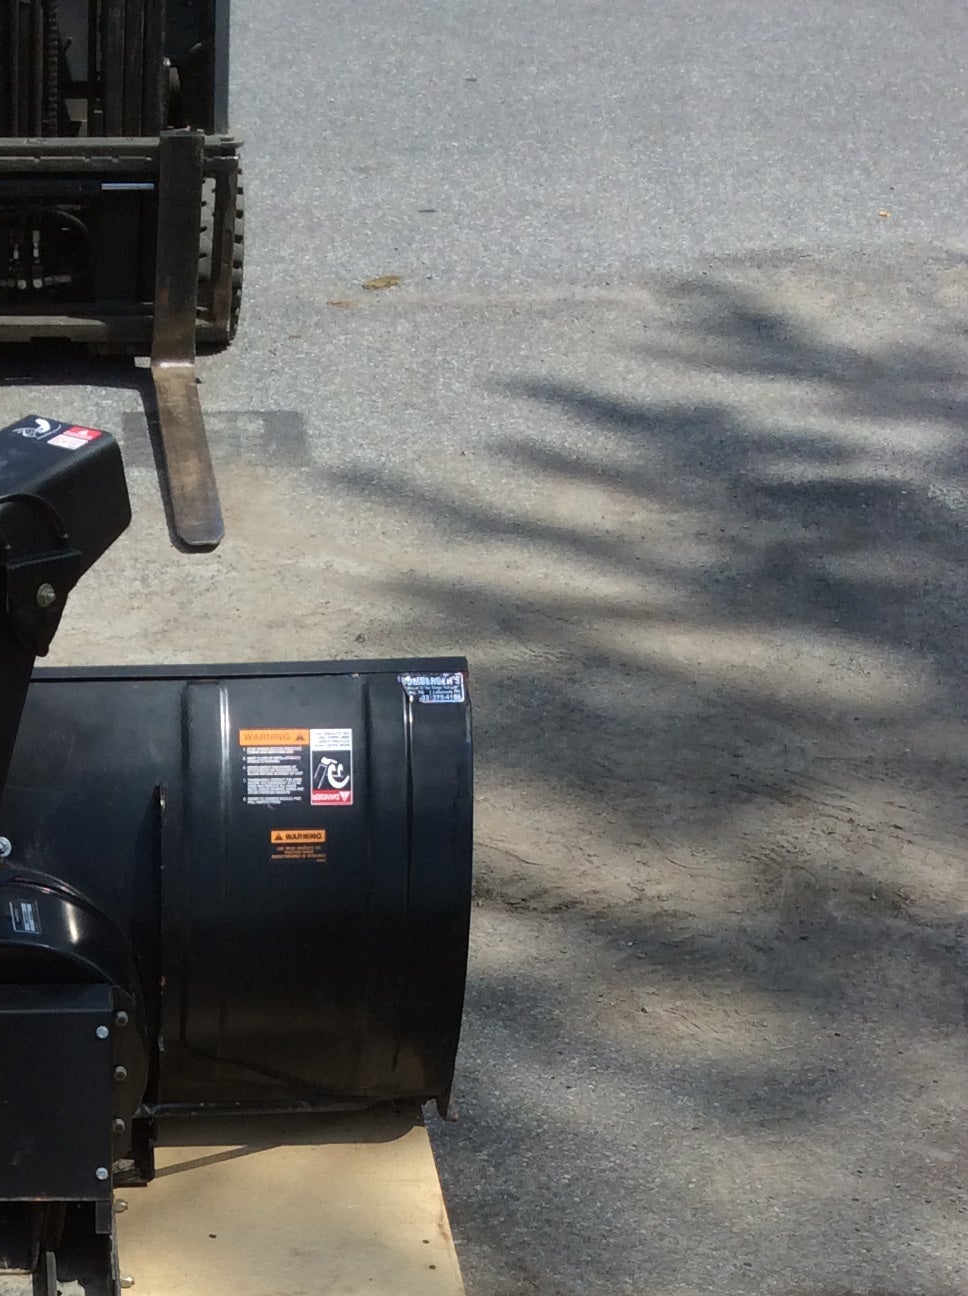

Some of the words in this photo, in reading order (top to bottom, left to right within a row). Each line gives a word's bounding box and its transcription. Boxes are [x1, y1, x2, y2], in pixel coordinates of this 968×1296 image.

[243, 732, 291, 741] WARNING
[311, 793, 340, 801] DANGER
[285, 832, 322, 840] WARNING
